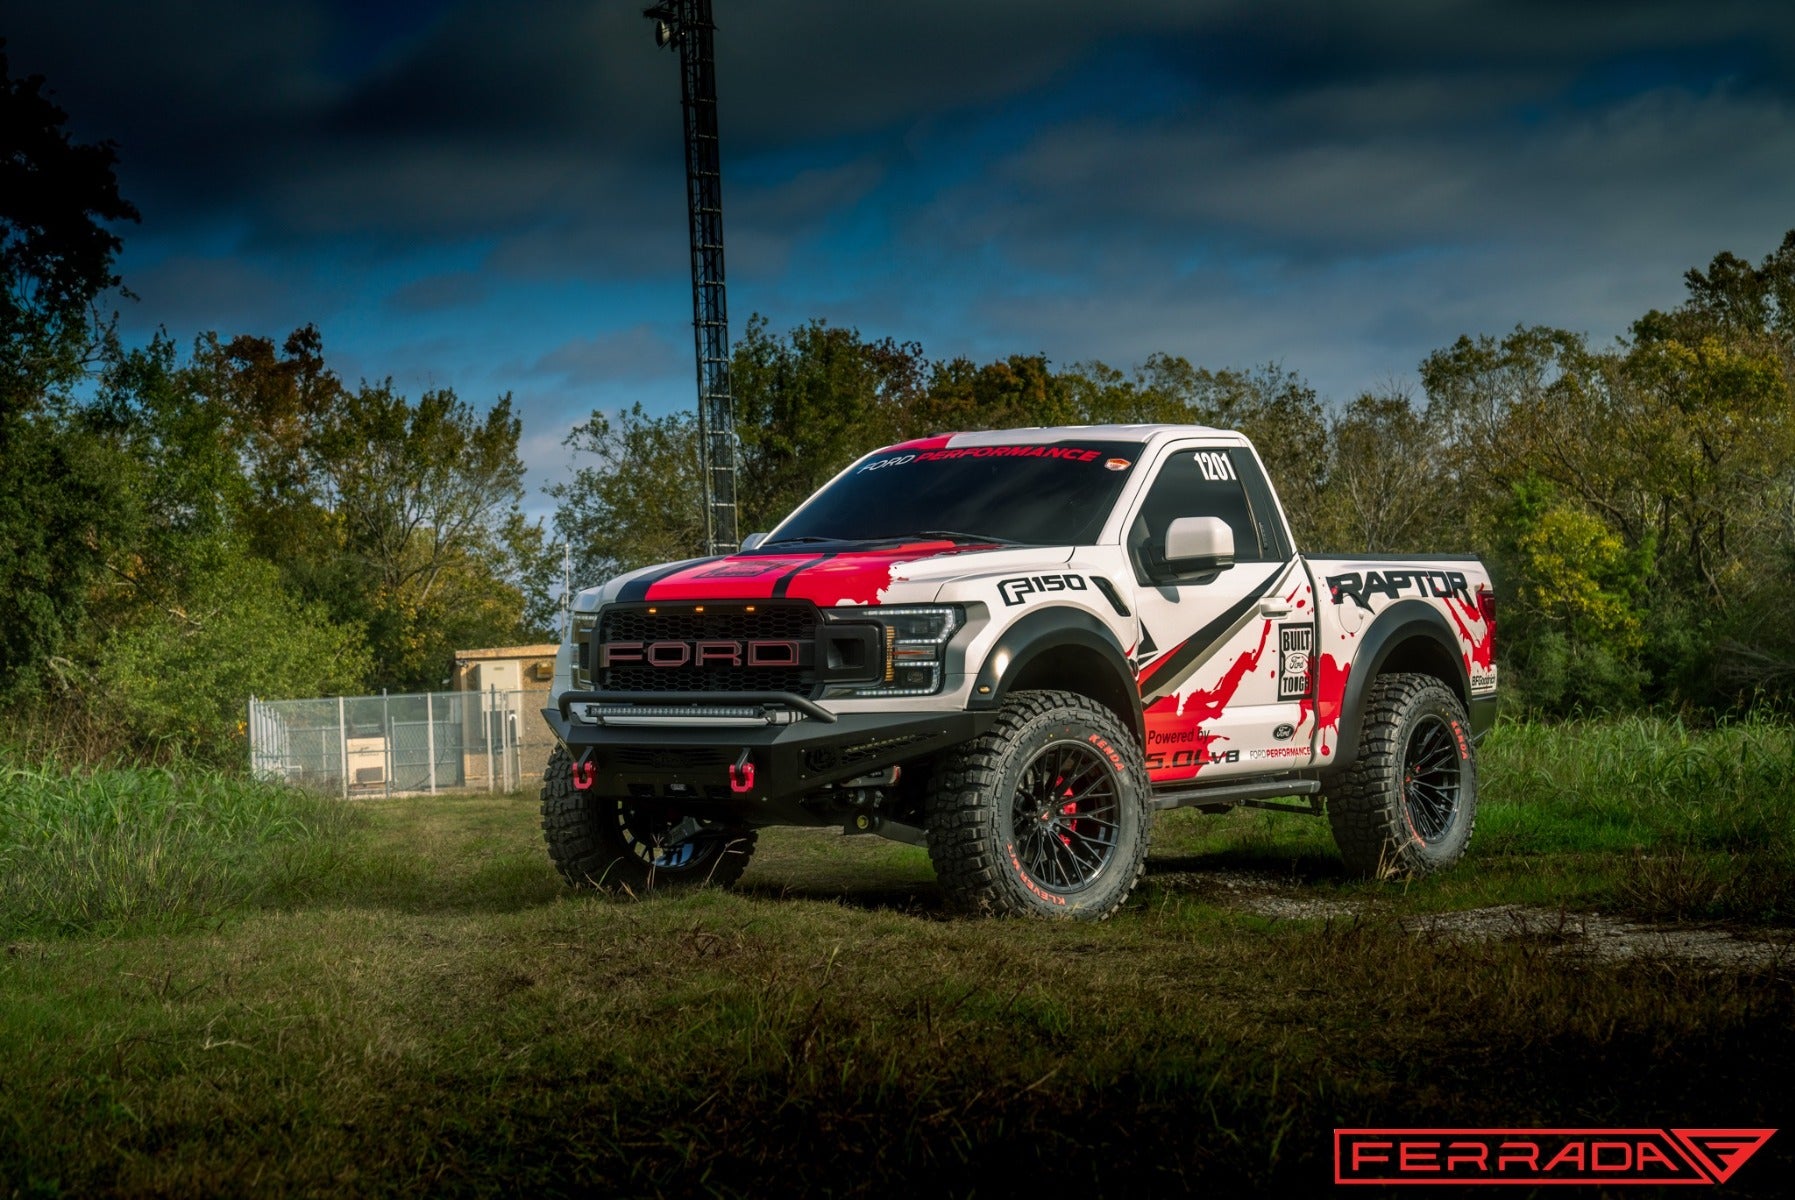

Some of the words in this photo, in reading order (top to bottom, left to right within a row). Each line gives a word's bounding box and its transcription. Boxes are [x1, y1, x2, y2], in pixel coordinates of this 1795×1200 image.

[857, 454, 914, 474] FORD
[914, 446, 1101, 463] PERFORMANCE
[1194, 452, 1237, 481] 1201
[1326, 570, 1477, 614] RAPTOR
[600, 640, 799, 667] FORD
[1283, 630, 1310, 651] BUILT
[1283, 676, 1309, 693] TOUGH
[1148, 731, 1194, 744] Powered
[1198, 729, 1211, 743] by
[1089, 733, 1125, 772] KENDA
[1266, 747, 1311, 758] PERFORMANCE
[1019, 870, 1066, 906] KLEVER
